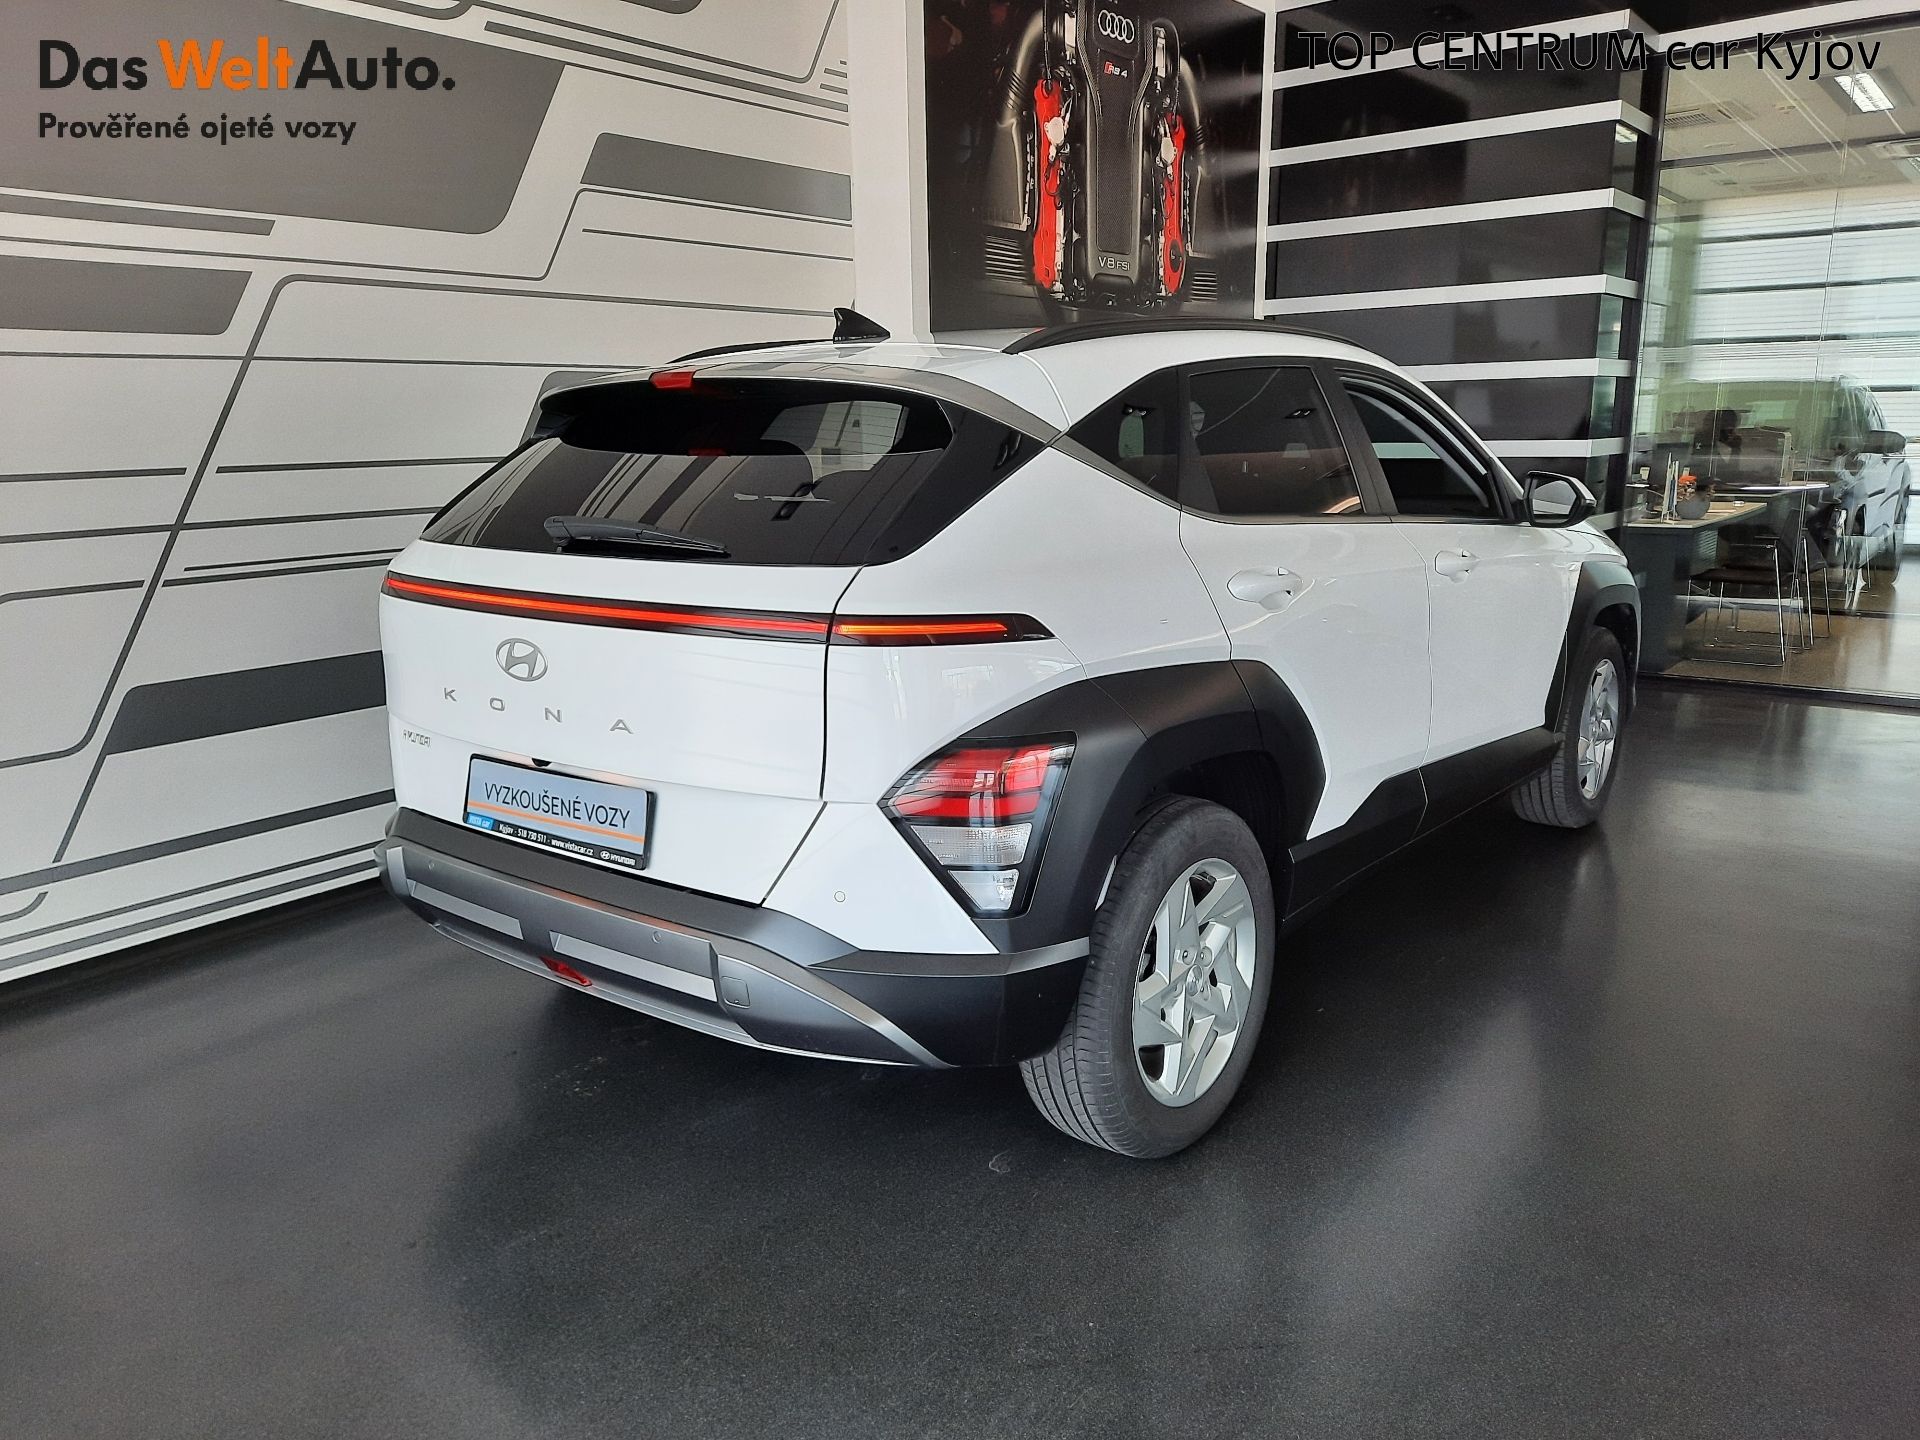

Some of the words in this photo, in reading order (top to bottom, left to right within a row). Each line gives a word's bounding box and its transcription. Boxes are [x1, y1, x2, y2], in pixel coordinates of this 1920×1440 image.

[1098, 256, 1115, 269] V8
[1116, 261, 1130, 271] FSI
[443, 687, 634, 735] KONA
[485, 782, 582, 820] VYZKOUŠENÉ
[584, 802, 631, 829] VOZY
[499, 823, 514, 835] Kyjov
[517, 828, 528, 838] 518
[528, 831, 537, 841] 730
[537, 833, 547, 844] 511
